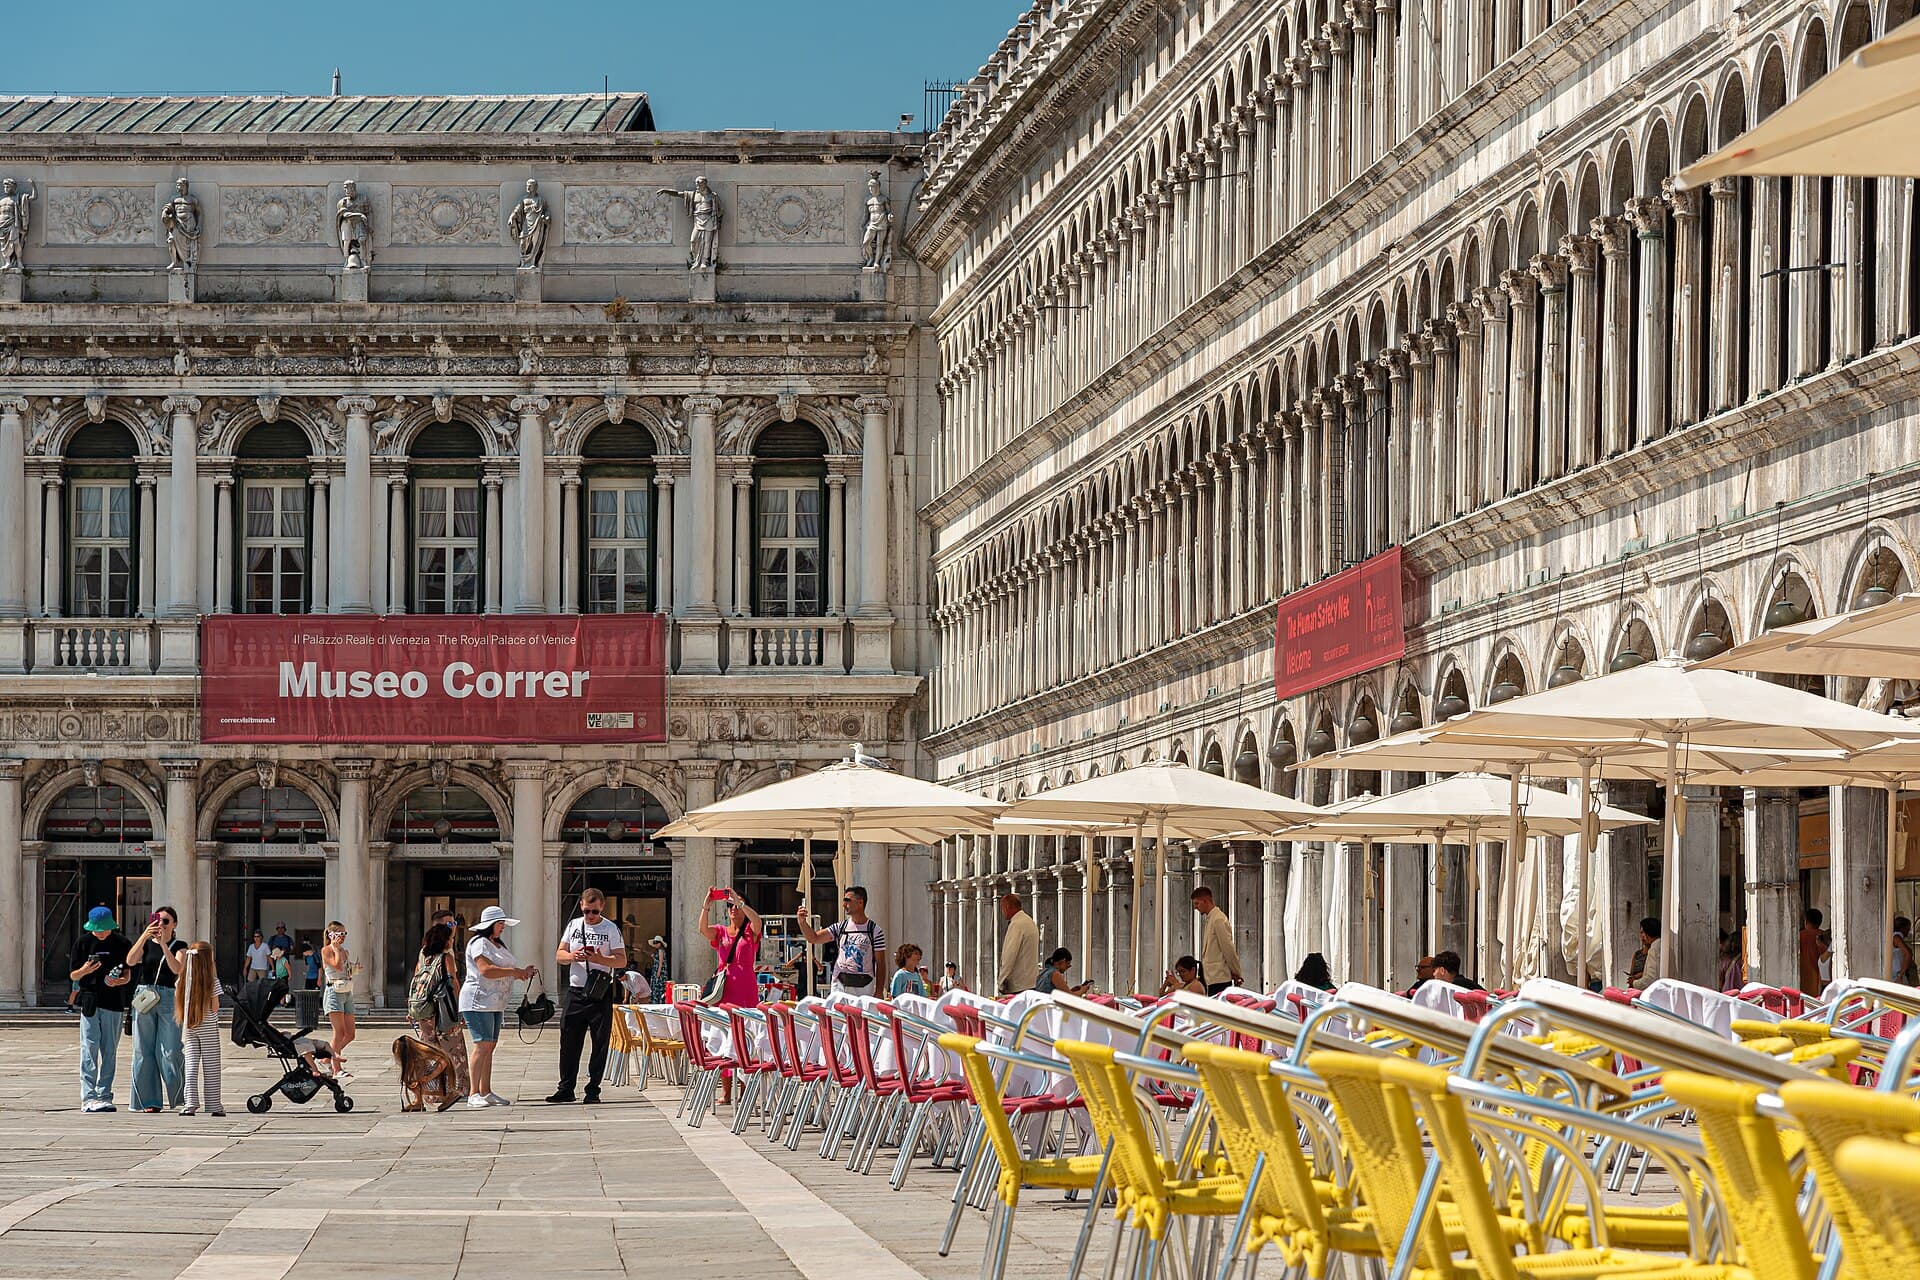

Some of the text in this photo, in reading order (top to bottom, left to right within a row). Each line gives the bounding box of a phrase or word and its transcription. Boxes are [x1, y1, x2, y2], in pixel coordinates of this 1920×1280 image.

[1297, 610, 1317, 637] Human
[294, 634, 577, 648] Il Palazzo Reale di Venezia The Royal Palace of Venice
[1286, 647, 1312, 676] Welcome
[278, 661, 590, 698] Museo Correr
